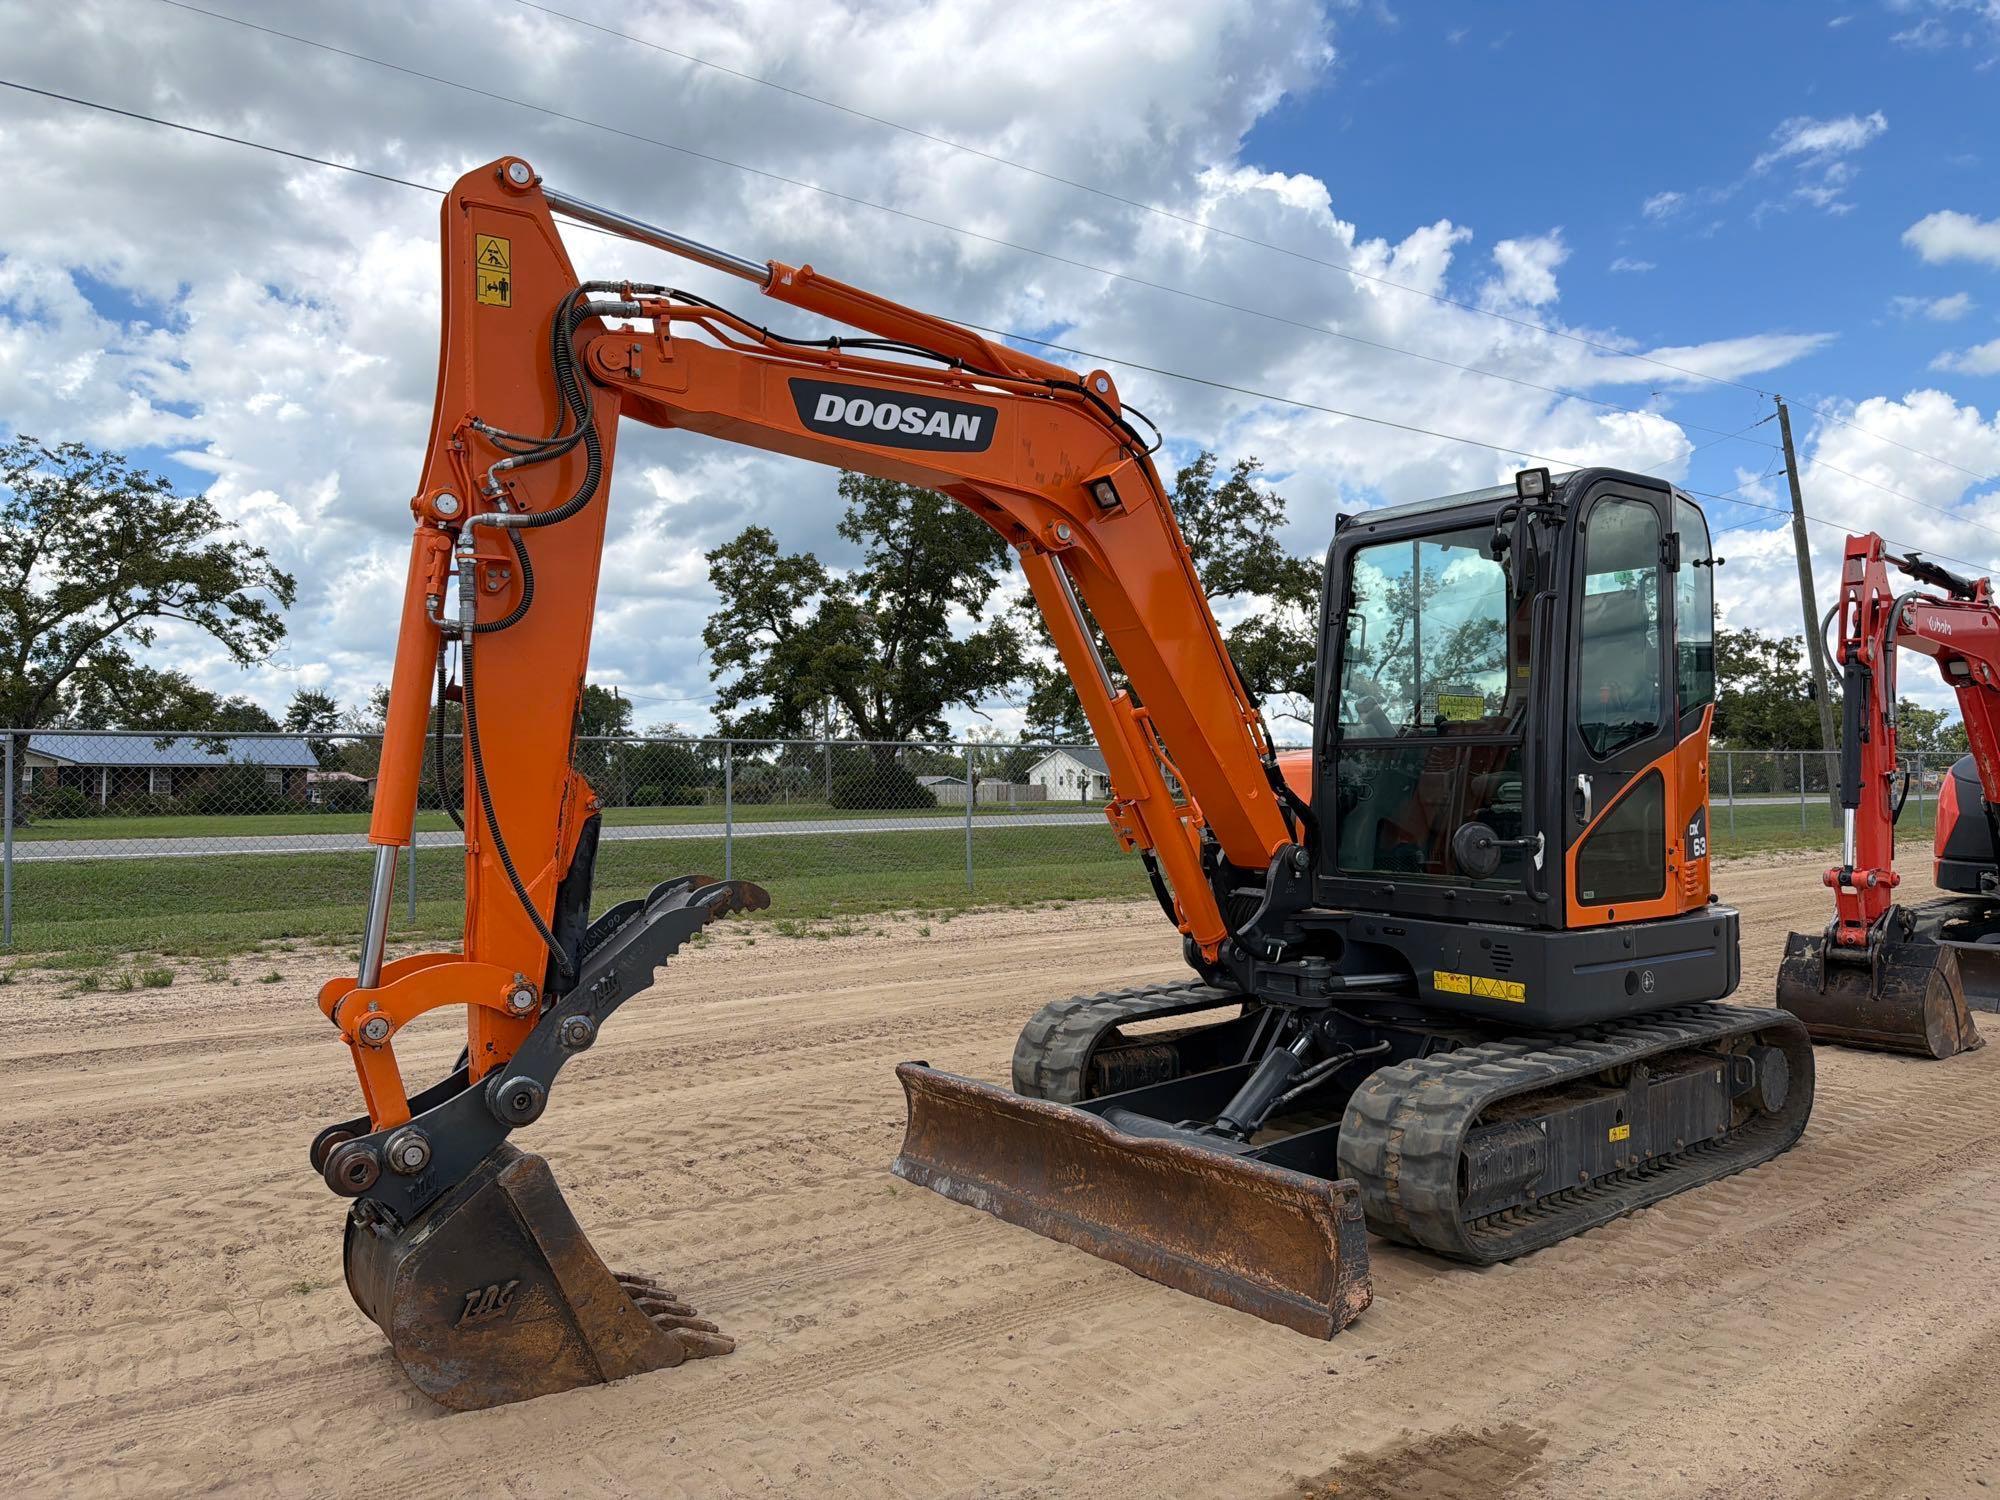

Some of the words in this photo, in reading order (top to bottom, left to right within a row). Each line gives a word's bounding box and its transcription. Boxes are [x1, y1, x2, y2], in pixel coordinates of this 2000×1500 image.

[813, 393, 982, 441] DOOSAN
[1927, 616, 1952, 636] Kubota
[1689, 819, 1701, 836] DX
[1693, 836, 1706, 857] 63
